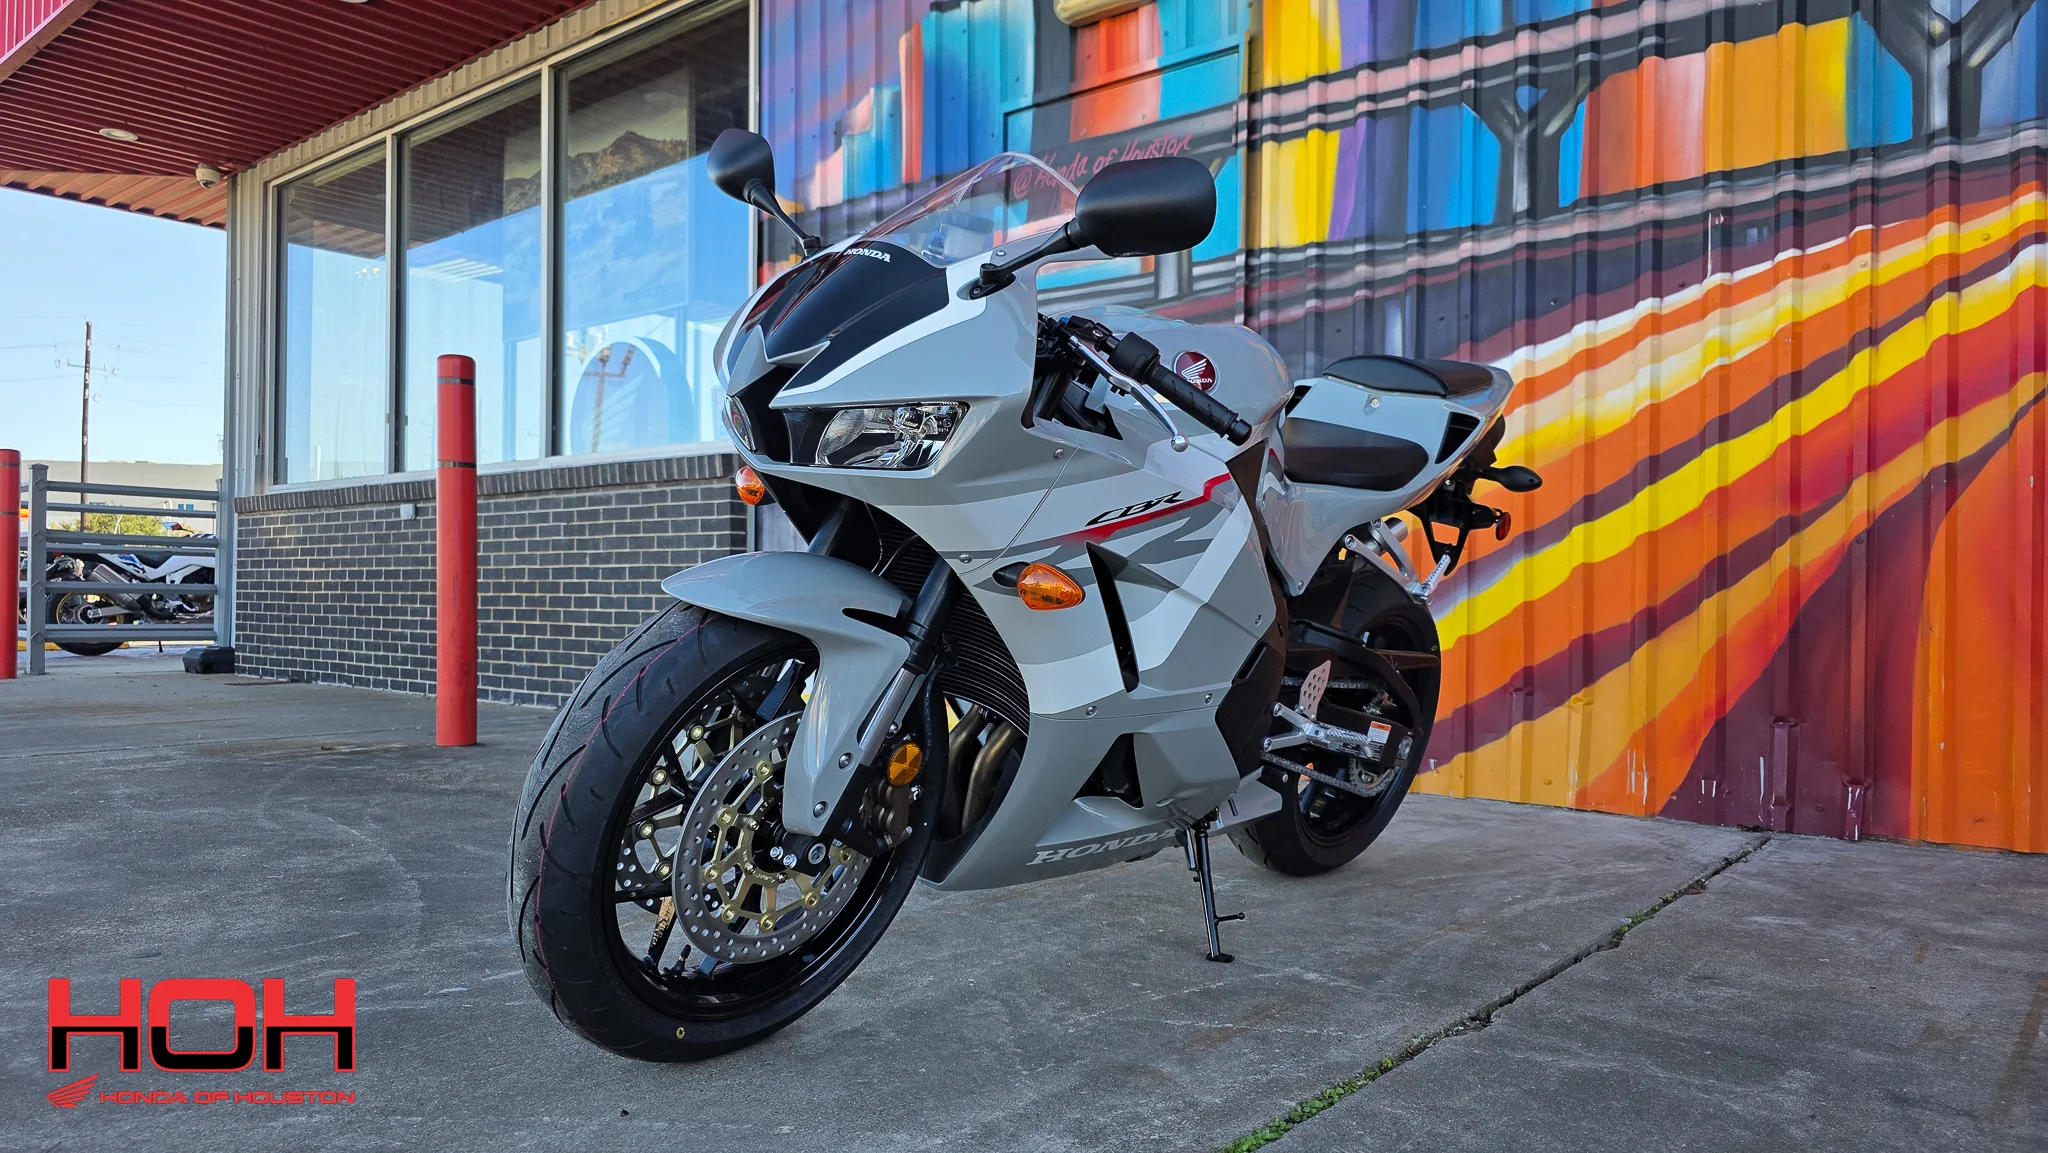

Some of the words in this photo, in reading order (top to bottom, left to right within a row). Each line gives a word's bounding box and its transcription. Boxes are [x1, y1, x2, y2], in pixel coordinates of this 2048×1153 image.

[1034, 152, 1088, 188] Honda
[843, 247, 891, 263] HONDA
[1084, 490, 1185, 527] CBR
[1026, 828, 1177, 866] HONDA
